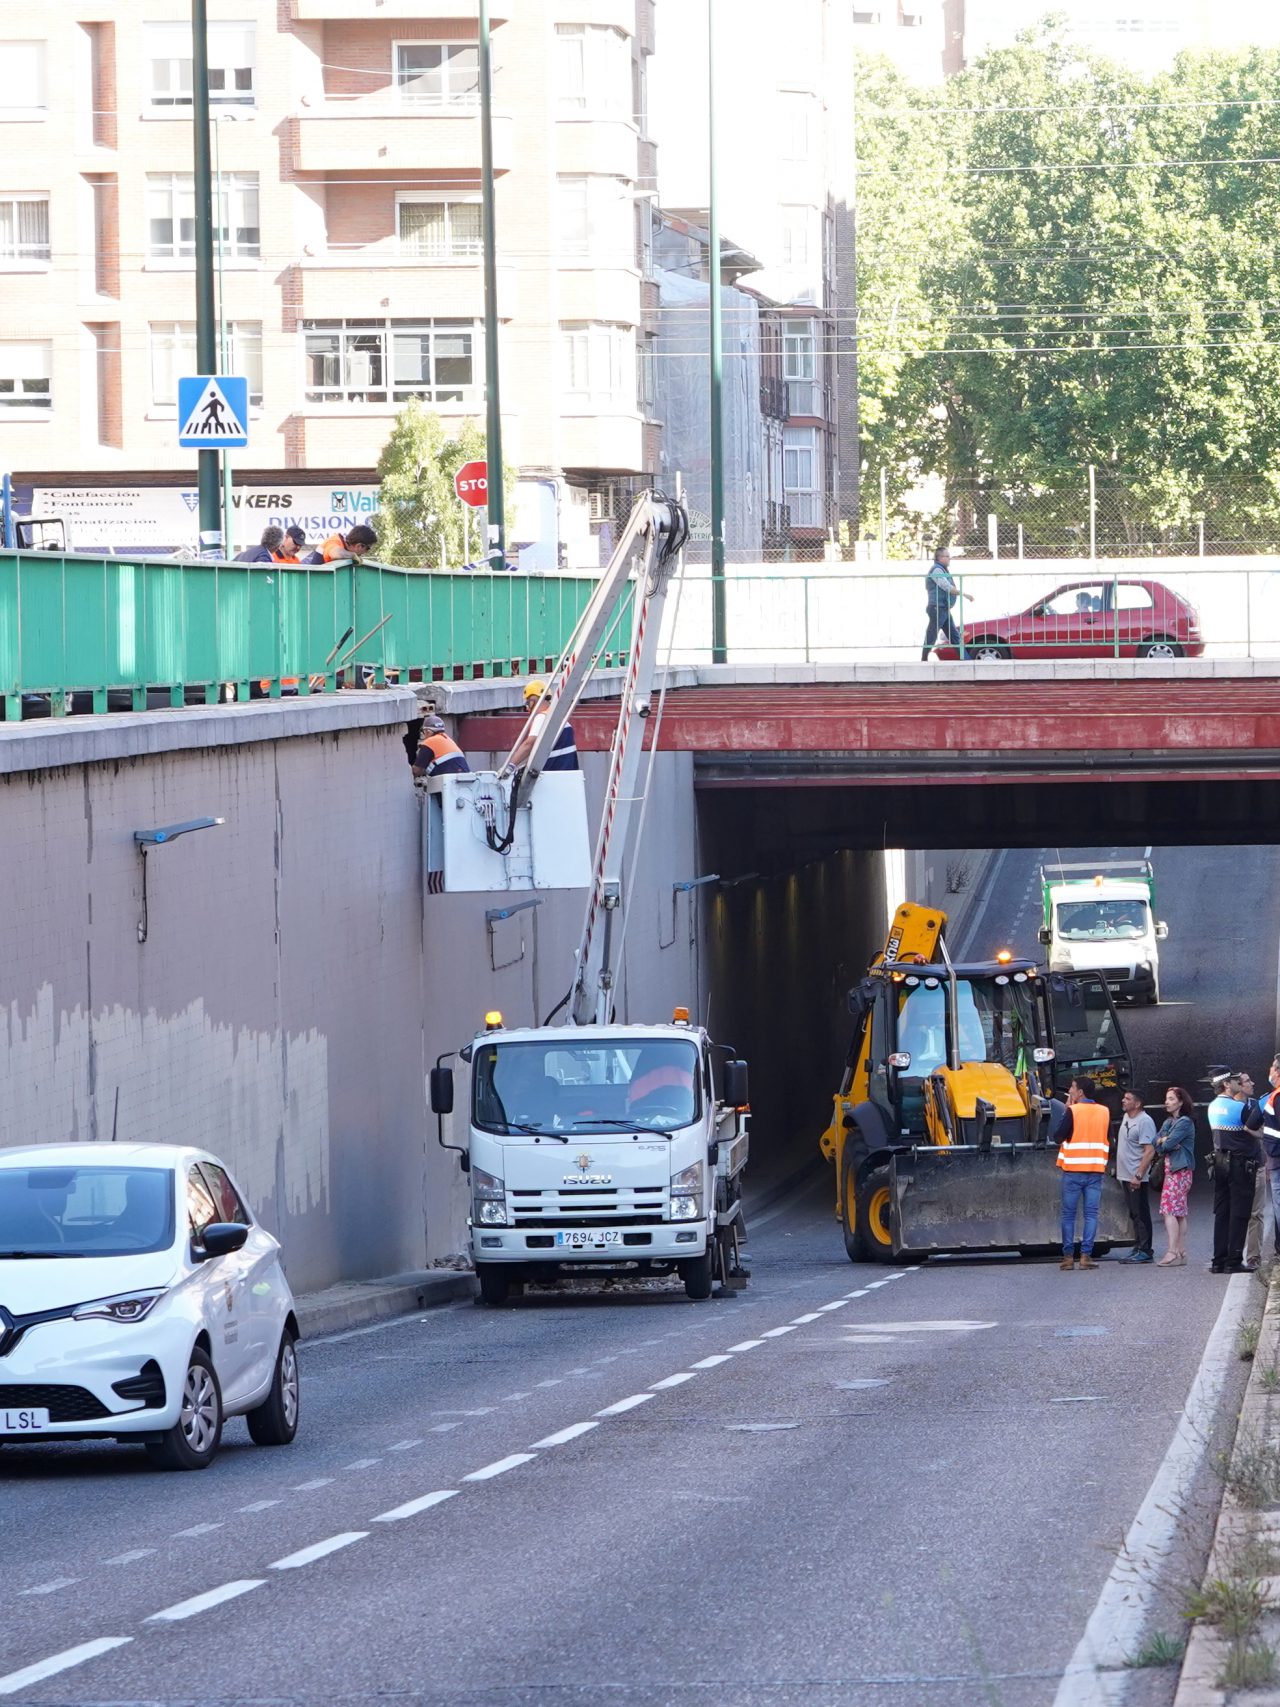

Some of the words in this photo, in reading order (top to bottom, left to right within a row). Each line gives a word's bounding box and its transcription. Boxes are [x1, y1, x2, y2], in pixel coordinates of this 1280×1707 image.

[460, 478, 488, 491] STO
[269, 516, 357, 530] DIVISION
[563, 1174, 612, 1185] ISUZU
[565, 1232, 594, 1243] 7694
[598, 1231, 619, 1243] JCZ
[6, 1411, 42, 1429] LSL
